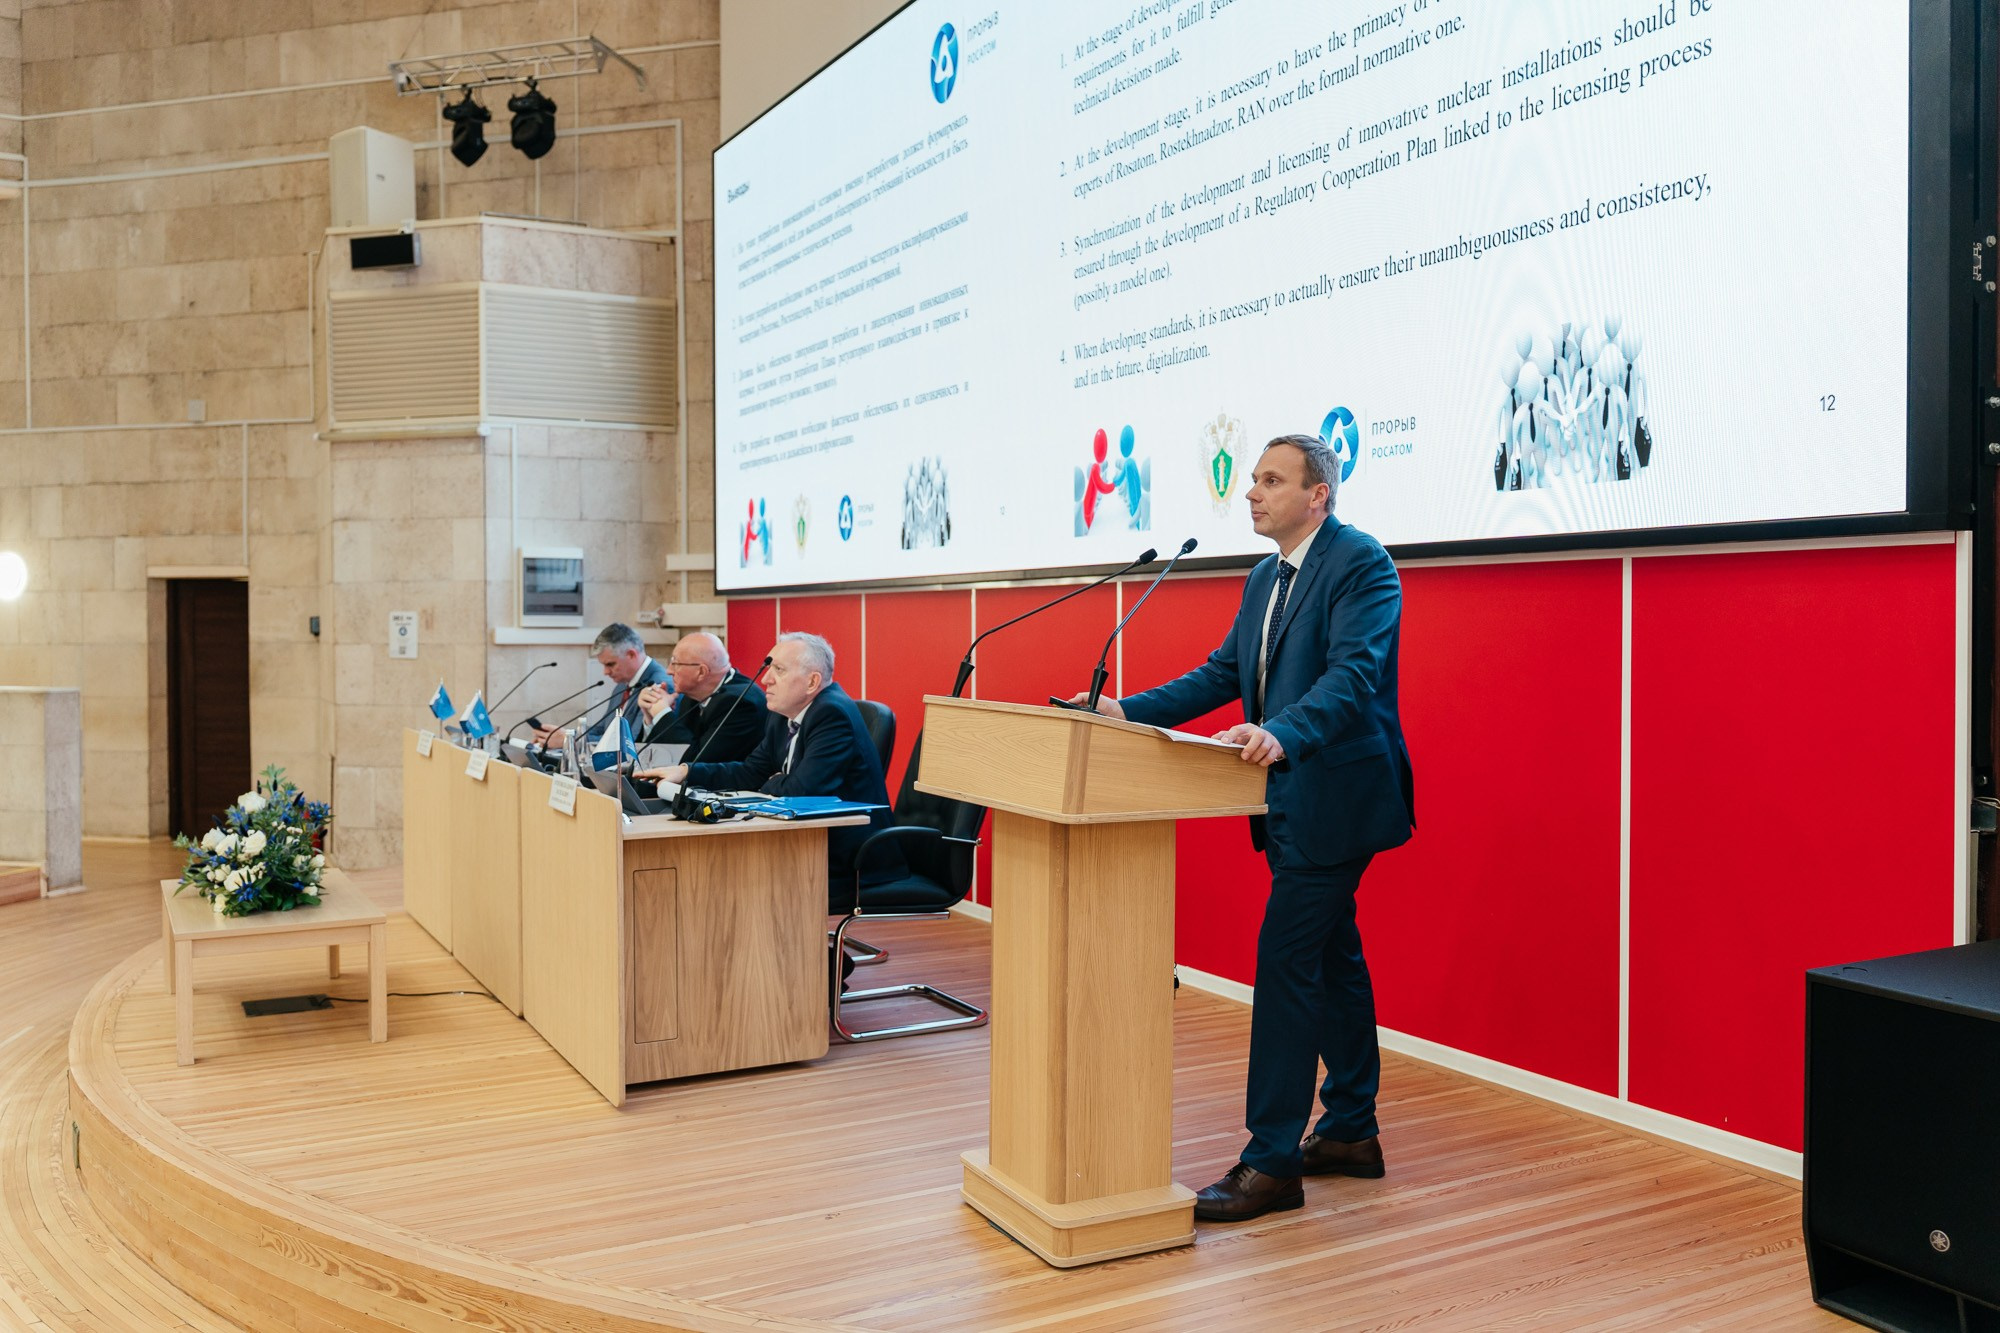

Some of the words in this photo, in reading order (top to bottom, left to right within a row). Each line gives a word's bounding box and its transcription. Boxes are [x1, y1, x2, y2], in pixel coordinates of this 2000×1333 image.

[1074, 45, 1084, 61] At
[1086, 36, 1099, 54] the
[1102, 24, 1123, 45] stage
[1125, 10, 1137, 31] of
[1138, 0, 1181, 24] develop
[1074, 50, 1127, 88] requirements
[1132, 38, 1145, 56] for
[1150, 29, 1156, 47] it
[1162, 26, 1171, 40] to
[1177, 1, 1204, 32] fulfill
[1074, 82, 1110, 115] technical
[1112, 65, 1152, 95] decisions
[1155, 48, 1182, 74] made.
[1074, 155, 1084, 171] At
[1088, 147, 1101, 164] the
[1104, 120, 1159, 156] development
[1164, 108, 1190, 129] stage,
[1196, 97, 1202, 114] it
[1208, 91, 1216, 109] is
[1221, 68, 1272, 102] necessary
[1278, 61, 1288, 75] to
[1295, 45, 1322, 68] have
[1328, 31, 1346, 52] the
[1354, 4, 1406, 47] primacy
[1074, 176, 1102, 199] experts
[1105, 163, 1115, 184] of
[1160, 118, 1234, 160] Rostekhnadzor,
[1238, 97, 1265, 126] RAN
[1269, 91, 1294, 112] over
[1298, 79, 1315, 100] the
[1320, 54, 1359, 91] formal
[1364, 30, 1430, 71] normative
[1436, 17, 1465, 39] one.
[1074, 216, 1141, 255] Synchronization
[1146, 204, 1157, 224] of
[1161, 201, 1175, 218] the
[1181, 175, 1244, 211] development
[1252, 160, 1270, 184] and
[1279, 142, 1330, 174] licensing
[1338, 127, 1352, 151] of
[1359, 105, 1428, 143] innovative
[1438, 80, 1492, 113] nuclear
[1503, 37, 1601, 89] installations
[1614, 0, 1676, 46] should
[1690, 0, 1712, 16] be
[1074, 253, 1105, 279] ensured
[1109, 241, 1141, 267] through
[1145, 236, 1158, 254] the
[1162, 214, 1224, 248] development
[1229, 203, 1241, 224] of
[1244, 206, 1250, 219] a
[1255, 181, 1316, 216] Regulatory
[1323, 150, 1400, 190] Cooperation
[1407, 137, 1437, 161] Plan
[1445, 111, 1489, 148] linked
[1498, 111, 1511, 129] to
[1520, 96, 1543, 121] the
[1553, 68, 1630, 110] licensing
[1639, 38, 1712, 87] process
[1074, 343, 1098, 360] When
[1100, 329, 1147, 354] developing
[1149, 314, 1195, 341] standards,
[1199, 310, 1205, 328] it
[1209, 307, 1217, 325] is
[1220, 296, 1271, 321] necessary
[1275, 293, 1285, 307] to
[1289, 274, 1335, 303] actually
[1339, 266, 1379, 289] ensure
[1385, 251, 1415, 277] their
[1420, 217, 1554, 267] unambiguousness
[1560, 198, 1590, 229] and
[1597, 173, 1711, 219] consistency,
[1074, 282, 1110, 311] (possibly
[1113, 283, 1117, 294] a
[1120, 268, 1146, 292] model
[1149, 263, 1172, 282] one).
[1074, 370, 1088, 389] and
[1091, 368, 1099, 384] in
[1101, 365, 1113, 382] the
[1116, 361, 1144, 378] future,
[1147, 342, 1210, 374] digitalization.
[1371, 416, 1416, 436] ПРОРЫВ
[1820, 394, 1836, 412] 12
[1371, 443, 1413, 459] РОСАТОМ
